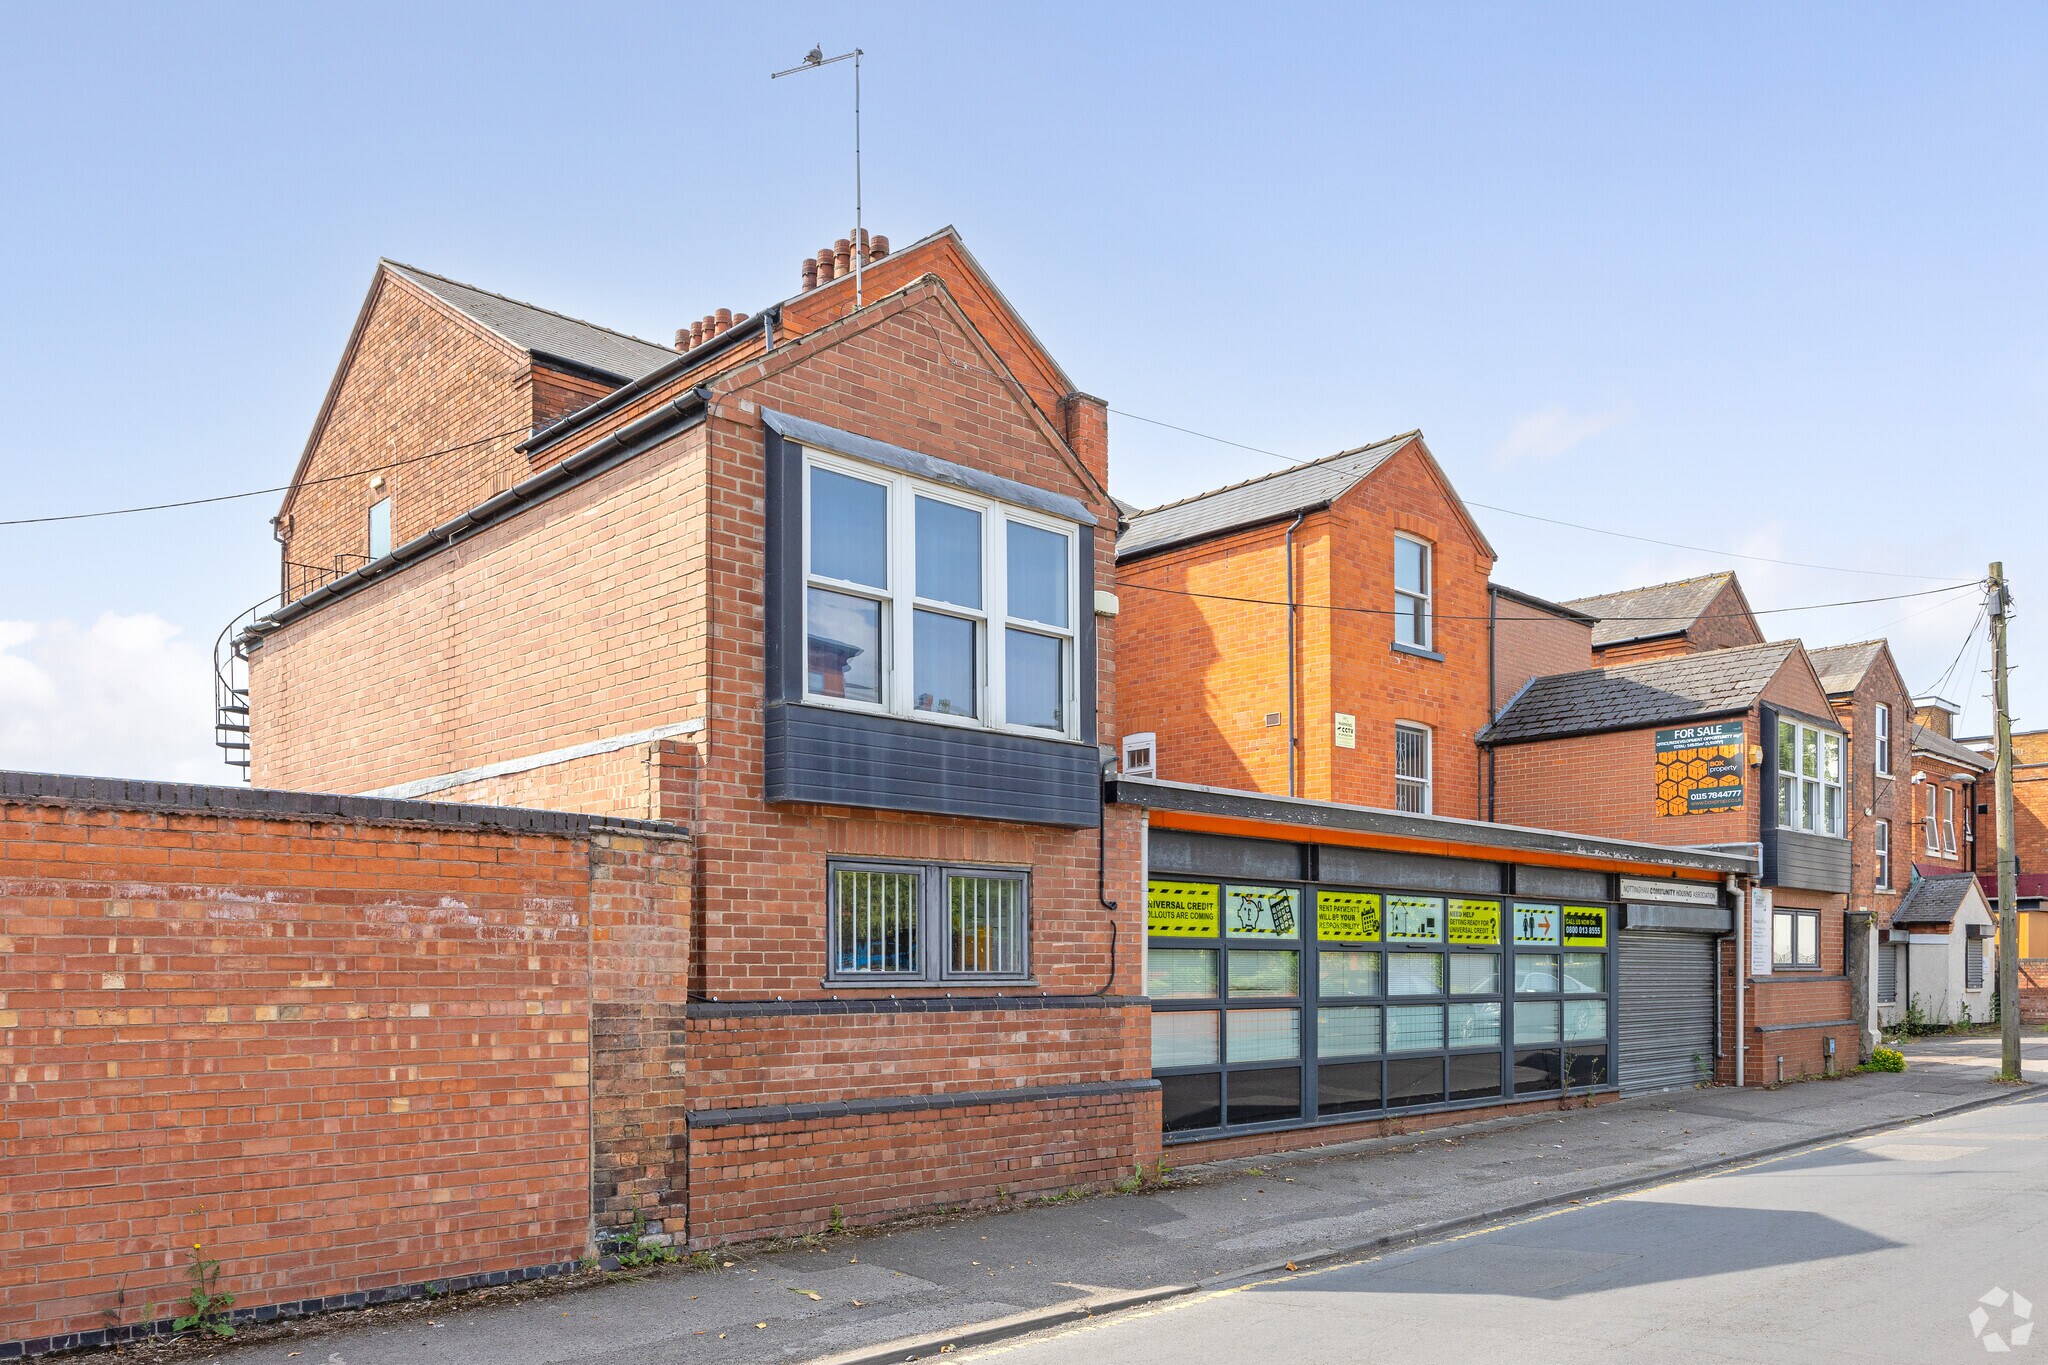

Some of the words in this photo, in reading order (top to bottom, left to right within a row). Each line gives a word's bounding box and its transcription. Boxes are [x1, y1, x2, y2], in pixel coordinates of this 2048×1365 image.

[1674, 728, 1694, 739] FOR
[1696, 725, 1722, 737] SALE
[1710, 765, 1737, 773] property
[1690, 792, 1707, 800] 0115
[1708, 790, 1741, 798] 7844777
[1623, 886, 1650, 894] NOTTINGHAM
[1650, 888, 1675, 896] COMMUNITY
[1148, 900, 1185, 909] NIVERSAL
[1187, 902, 1213, 910] CREDIT
[1190, 912, 1213, 920] COMING
[1566, 926, 1578, 934] 0800
[1579, 926, 1588, 934] 013
[1589, 927, 1600, 935] 8555
